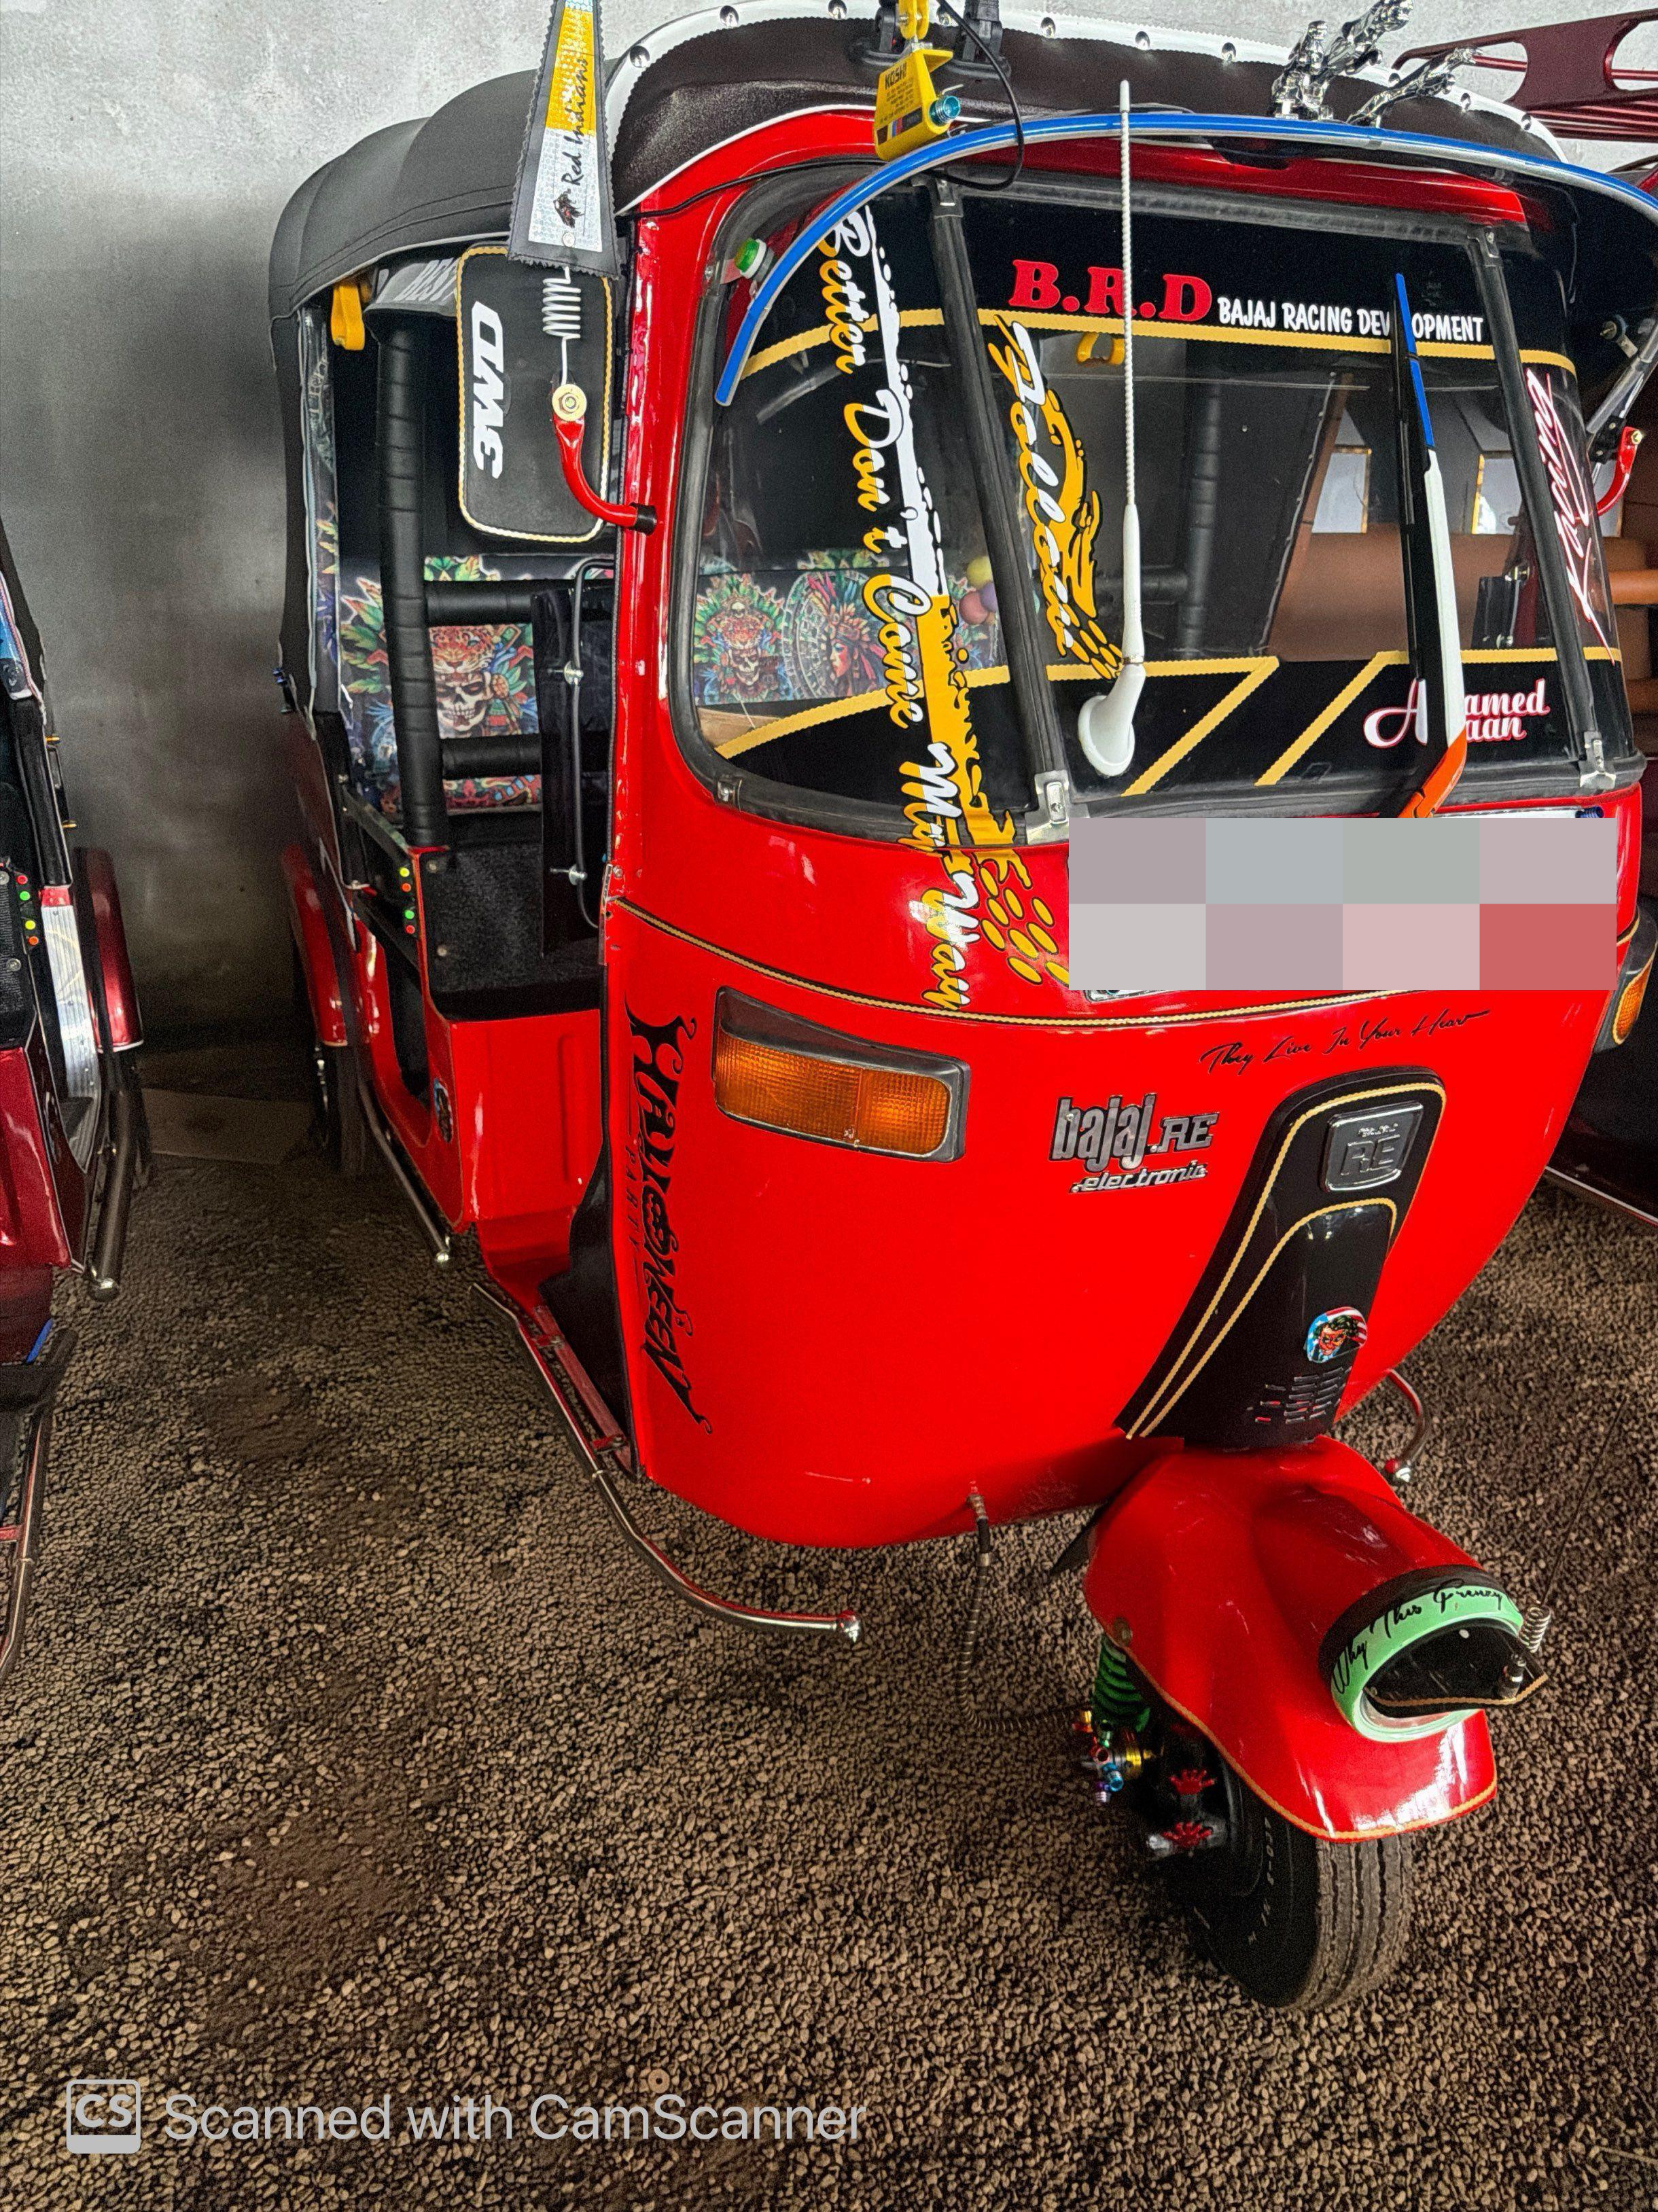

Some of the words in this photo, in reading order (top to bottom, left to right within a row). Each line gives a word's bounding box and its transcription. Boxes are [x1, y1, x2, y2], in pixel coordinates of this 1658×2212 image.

[563, 57, 593, 145] Indians
[562, 151, 582, 187] Red
[818, 211, 871, 375] Better
[1010, 261, 1212, 322] B.R.D
[1217, 296, 1276, 329] BAJAJ
[1282, 302, 1352, 335] RACING
[1356, 308, 1484, 343] DEVOPMENT
[472, 301, 504, 480] 3WD
[843, 389, 919, 554] Don't
[989, 315, 1072, 656] Follow
[861, 573, 932, 730] Come
[1200, 1041, 1254, 1075] They
[1263, 1036, 1311, 1063] Live
[1322, 1027, 1350, 1054] In
[1359, 1018, 1401, 1050] Your
[1049, 1093, 1157, 1173] bajaj
[1340, 1134, 1400, 1176] RE
[1332, 1639, 1368, 1694] Why
[1369, 1602, 1422, 1639] This
